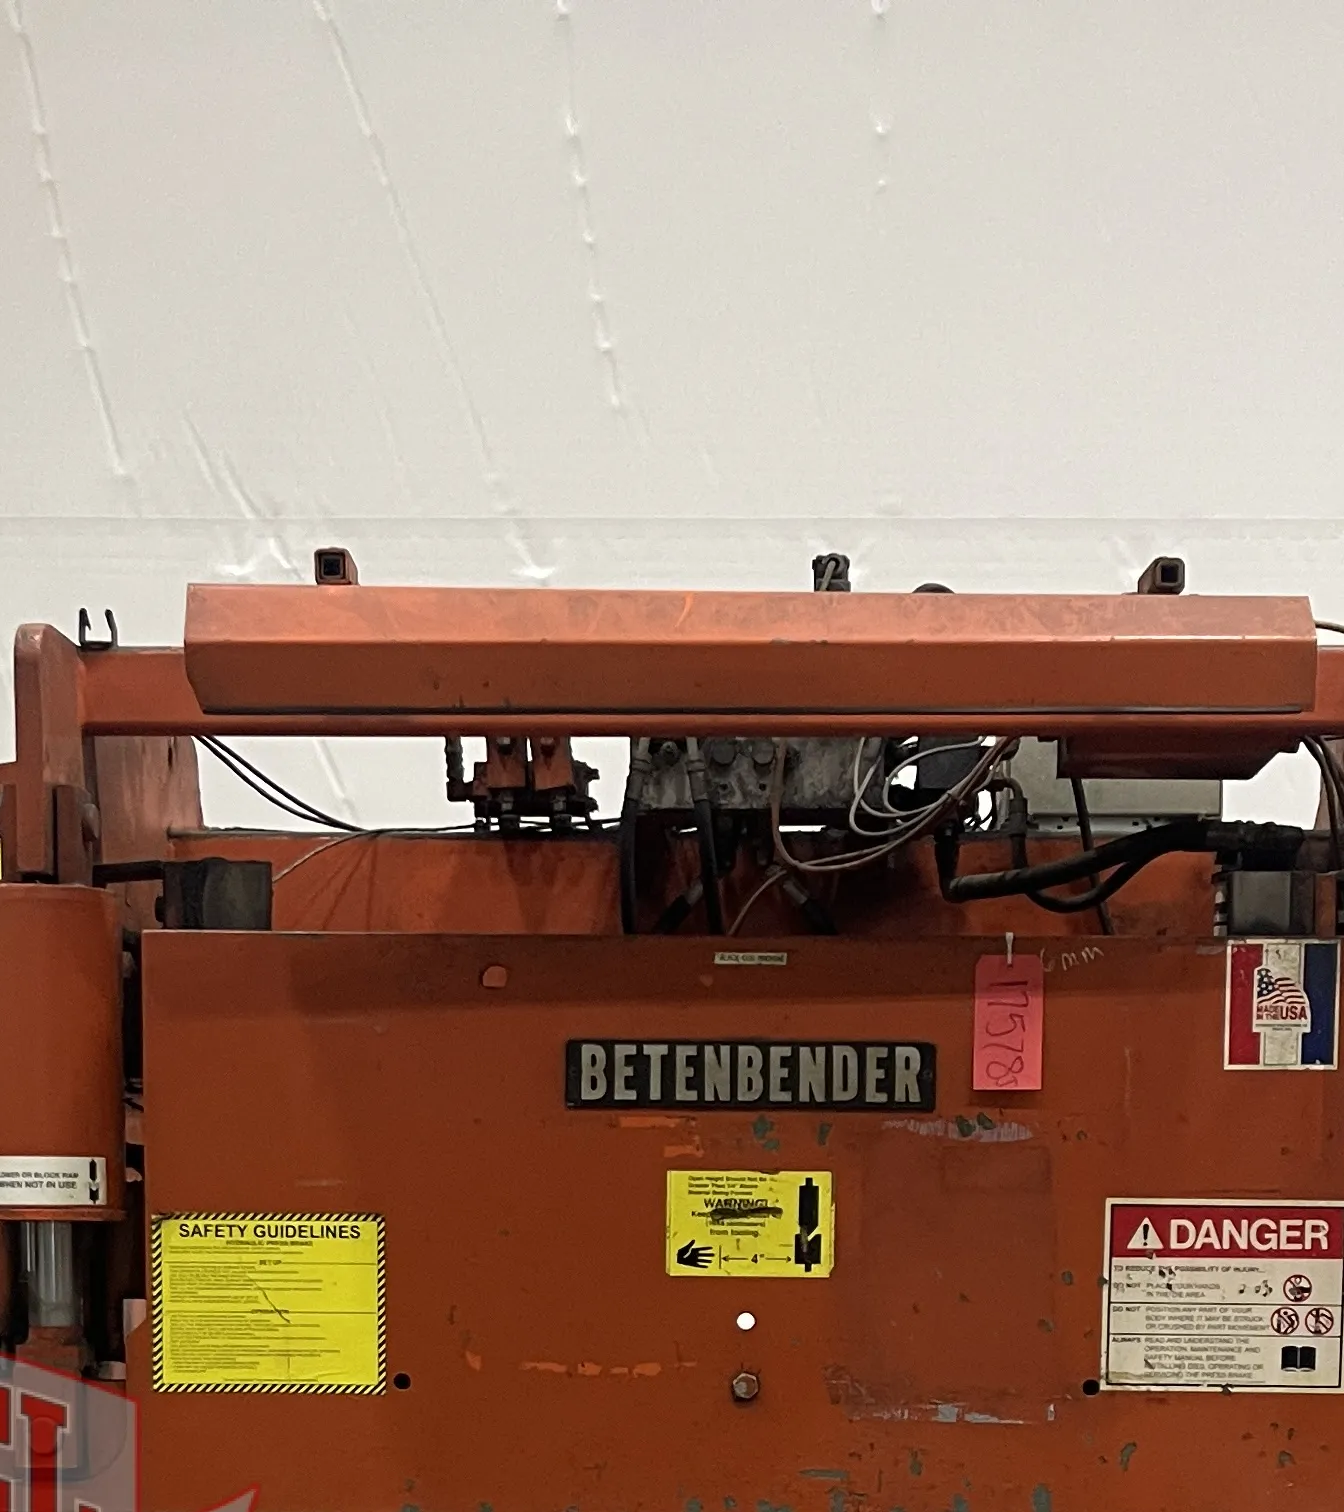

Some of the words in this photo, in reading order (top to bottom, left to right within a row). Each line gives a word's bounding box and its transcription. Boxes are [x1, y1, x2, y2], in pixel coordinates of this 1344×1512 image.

[1280, 1005, 1308, 1020] USA
[580, 1043, 922, 1104] BETENBENDER
[0, 1181, 22, 1189] WHEN
[24, 1181, 43, 1189] NOT
[46, 1181, 56, 1189] IN
[58, 1181, 77, 1189] USE
[179, 1224, 247, 1238] SAFETY
[253, 1225, 361, 1239] GUIDELINES
[1169, 1218, 1329, 1250] DANGER
